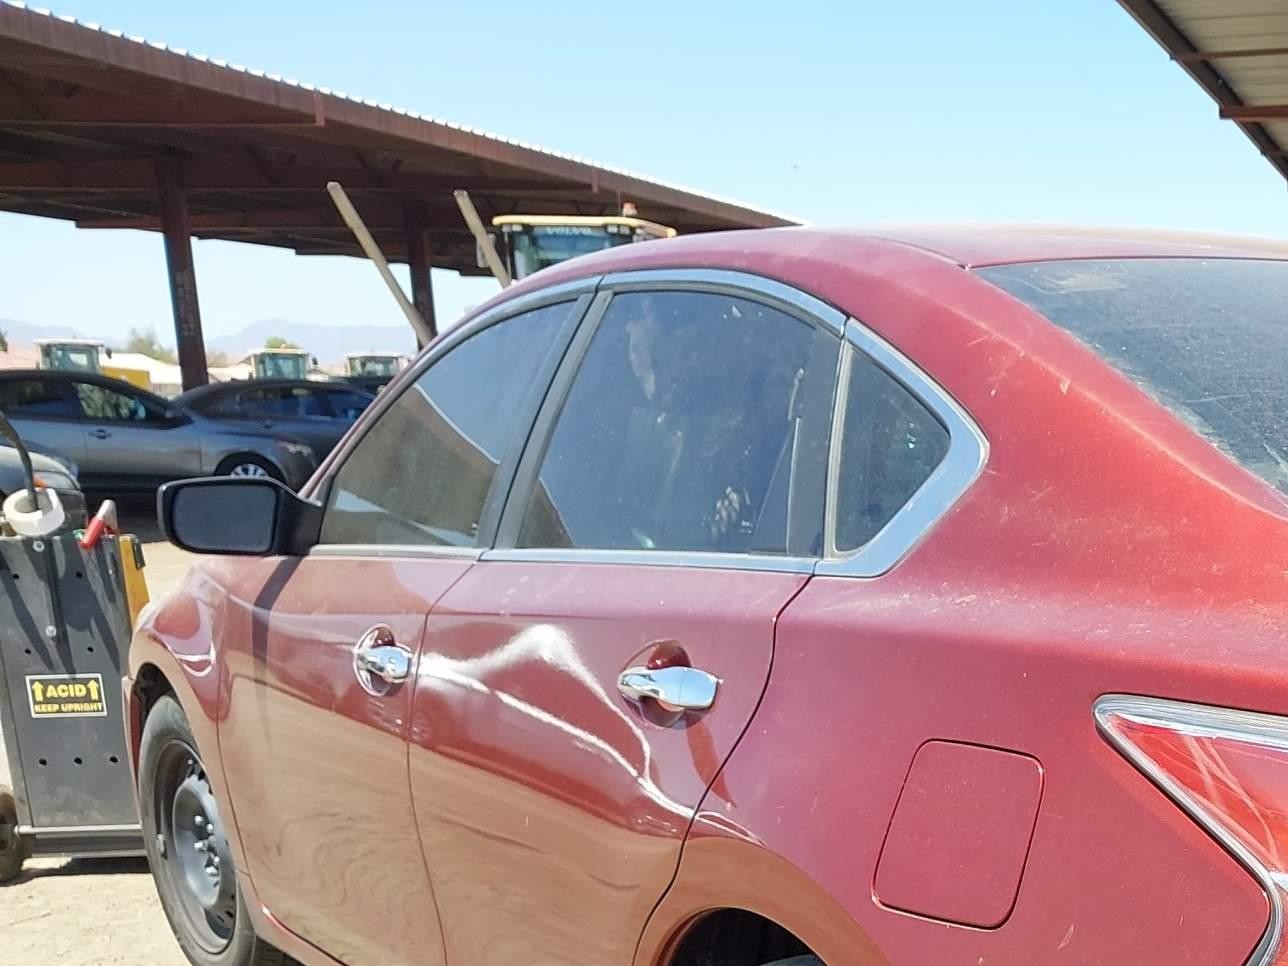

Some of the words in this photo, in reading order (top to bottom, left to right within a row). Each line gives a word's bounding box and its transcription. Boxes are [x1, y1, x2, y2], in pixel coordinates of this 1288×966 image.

[46, 683, 87, 698] ACID
[34, 703, 60, 713] KEEP
[60, 702, 103, 713] UPRIGHT
